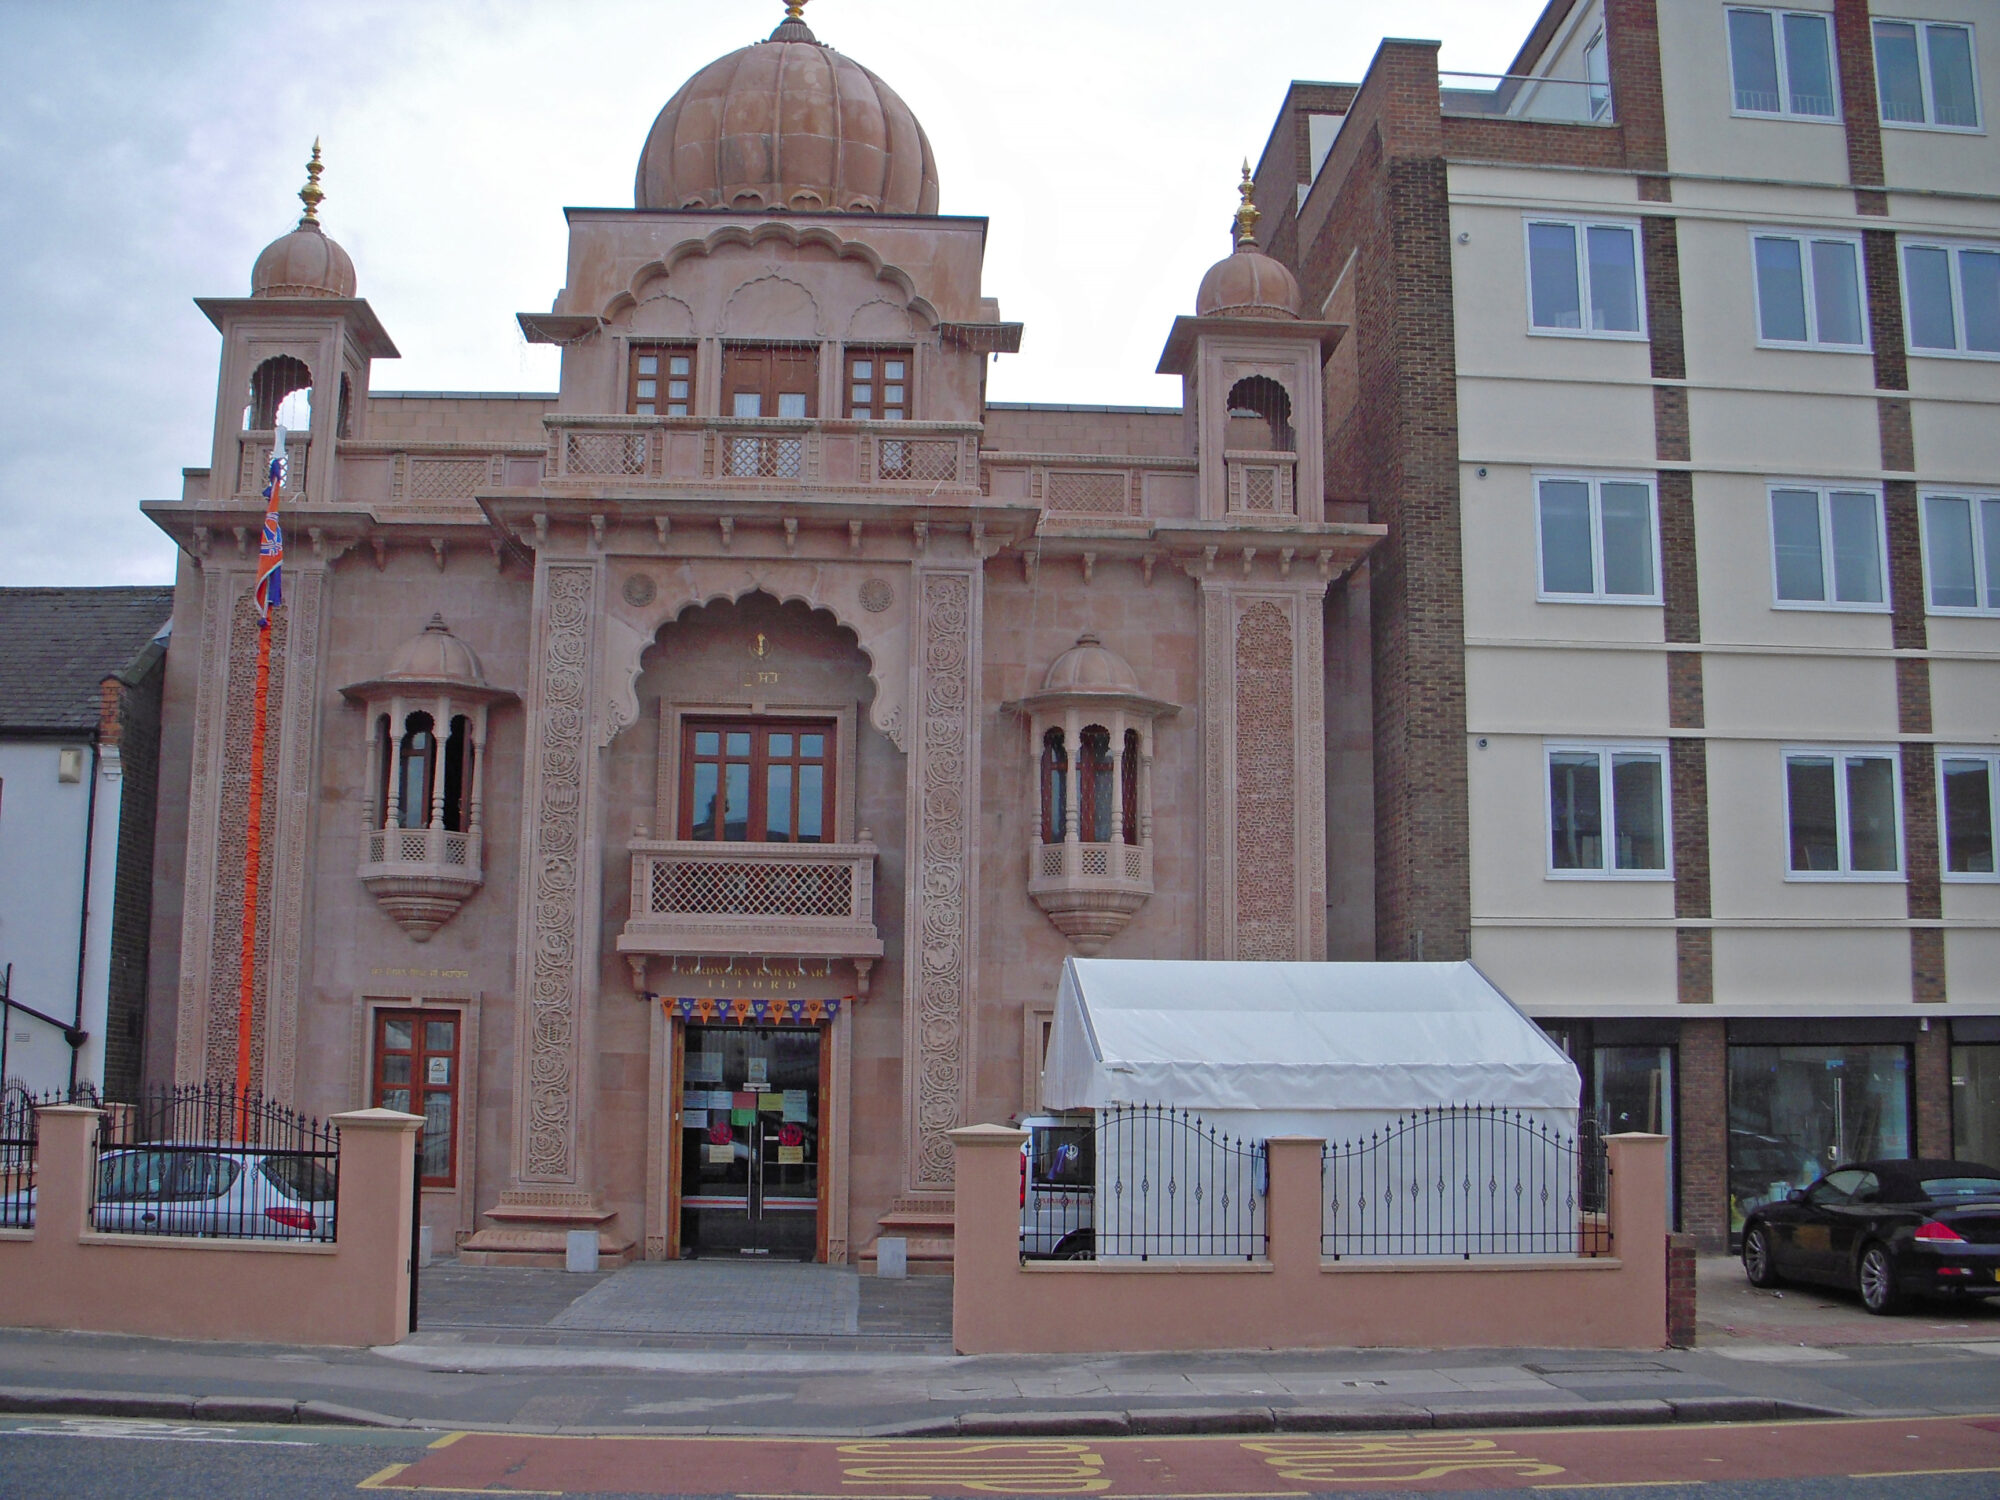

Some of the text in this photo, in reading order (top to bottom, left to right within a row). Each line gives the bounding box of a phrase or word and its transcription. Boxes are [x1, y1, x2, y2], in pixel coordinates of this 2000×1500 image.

[708, 978, 796, 990] ILFORD
[757, 967, 824, 977] KRAMAR
[836, 1443, 1112, 1493] STOP
[1240, 1439, 1566, 1482] BUS
